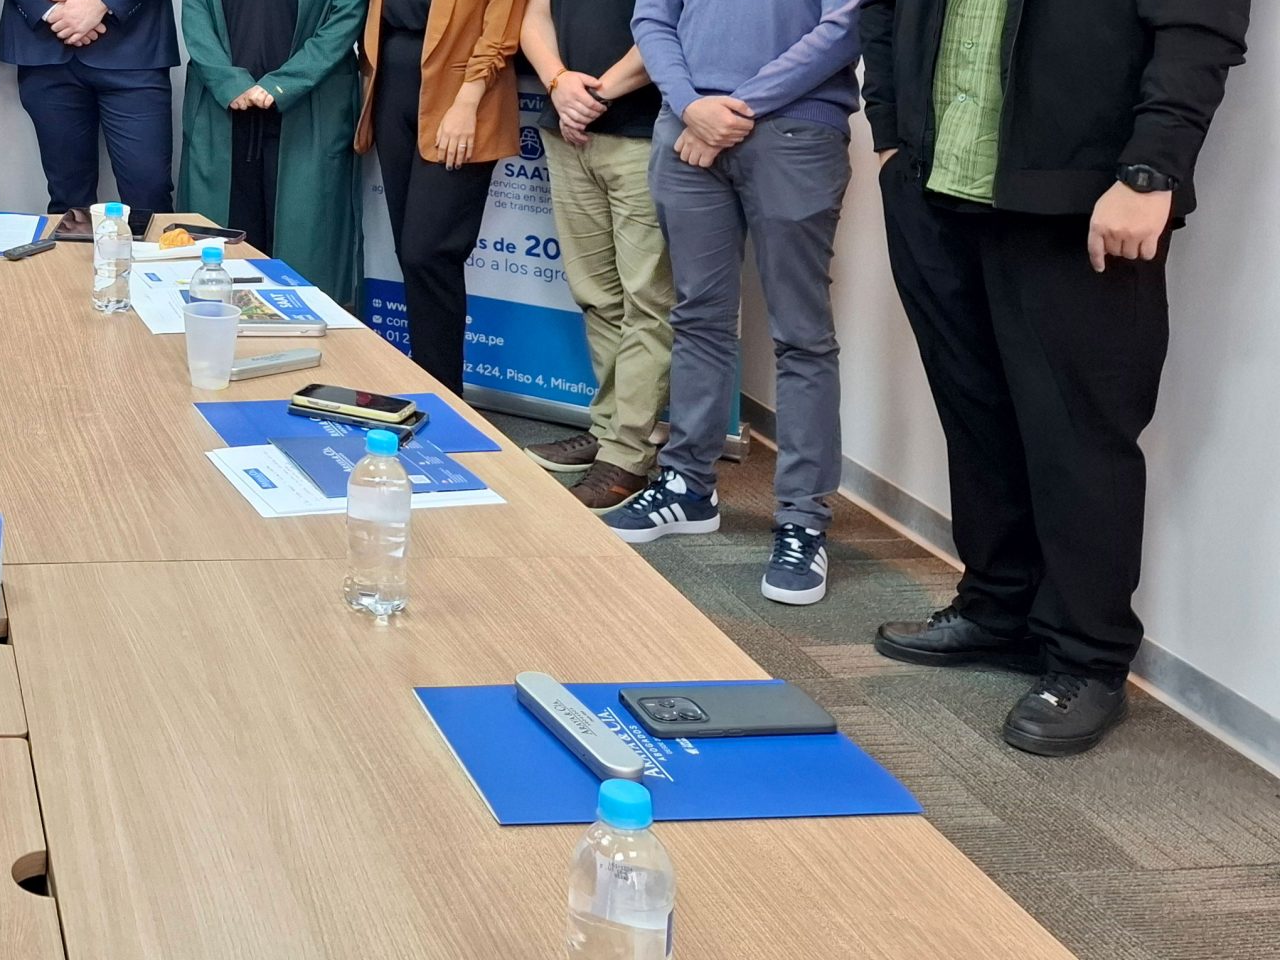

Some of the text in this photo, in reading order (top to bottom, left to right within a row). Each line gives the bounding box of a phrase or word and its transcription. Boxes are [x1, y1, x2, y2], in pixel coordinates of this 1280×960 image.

[504, 163, 550, 182] SAAT
[489, 189, 520, 200] tencia
[523, 194, 536, 202] en
[494, 200, 553, 215] de transpor
[493, 237, 517, 254] de
[524, 234, 561, 260] 20
[465, 253, 568, 283] do a los agro
[386, 301, 407, 312] ww
[386, 330, 400, 343] 01
[464, 331, 504, 346] aya.pe
[463, 360, 600, 396] iz 424, Piso 4, Miraflor
[629, 725, 667, 762] ABOGADOS
